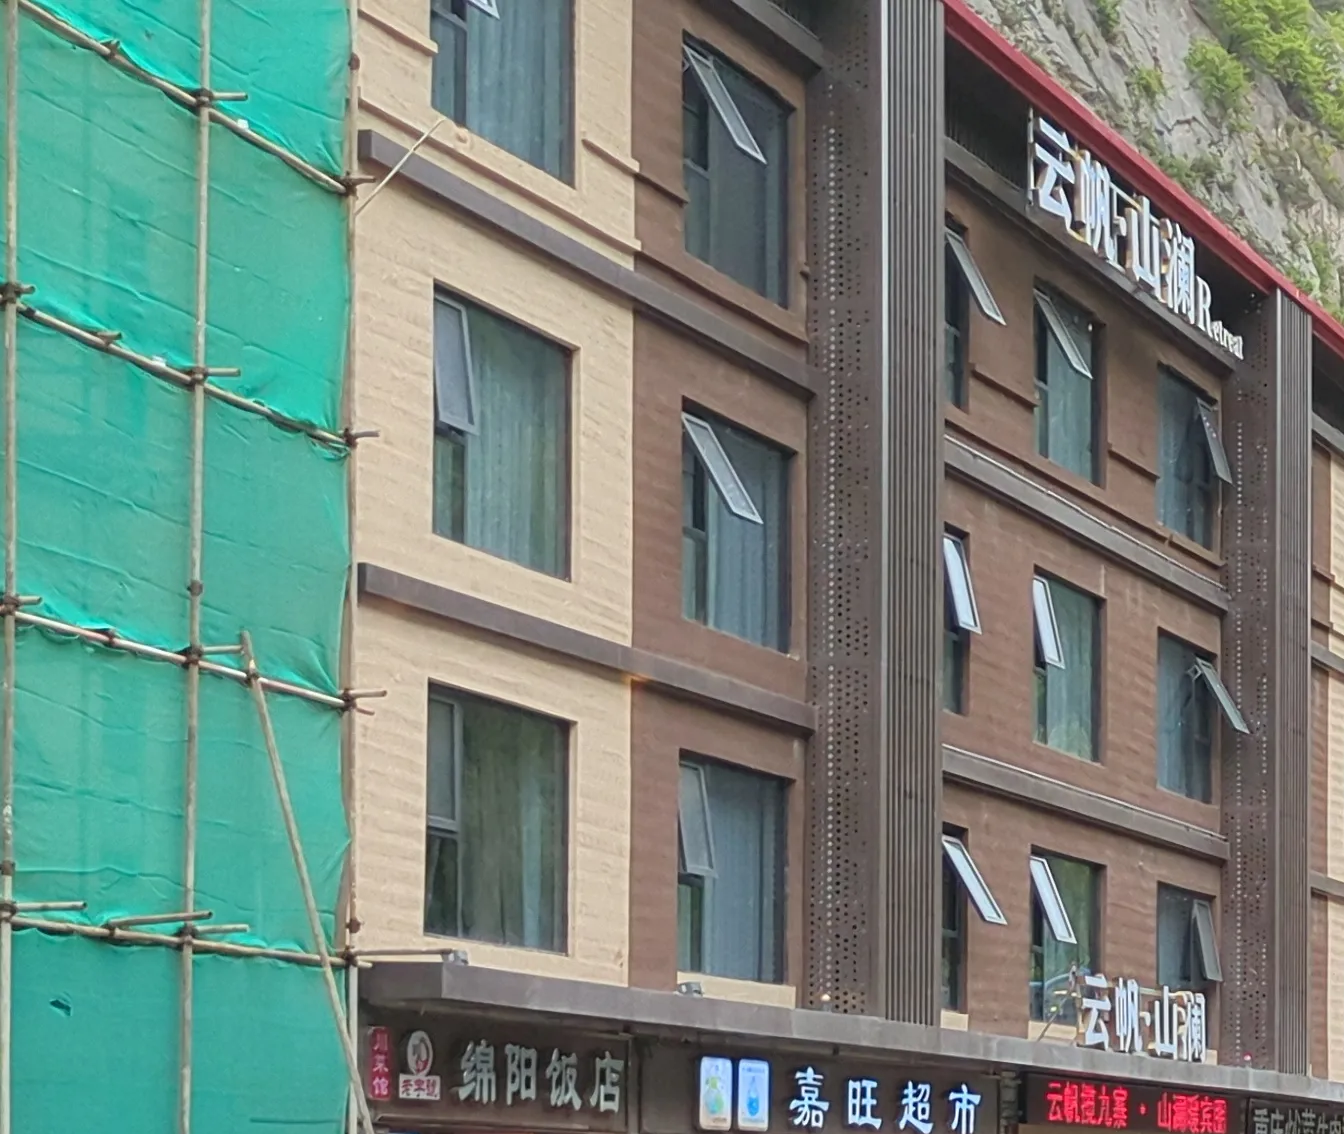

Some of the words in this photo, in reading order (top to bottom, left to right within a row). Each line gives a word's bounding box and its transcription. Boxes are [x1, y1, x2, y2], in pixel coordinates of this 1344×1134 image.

[372, 1031, 389, 1096] 川菜馆
[458, 1038, 625, 1114] 绵阳饭店
